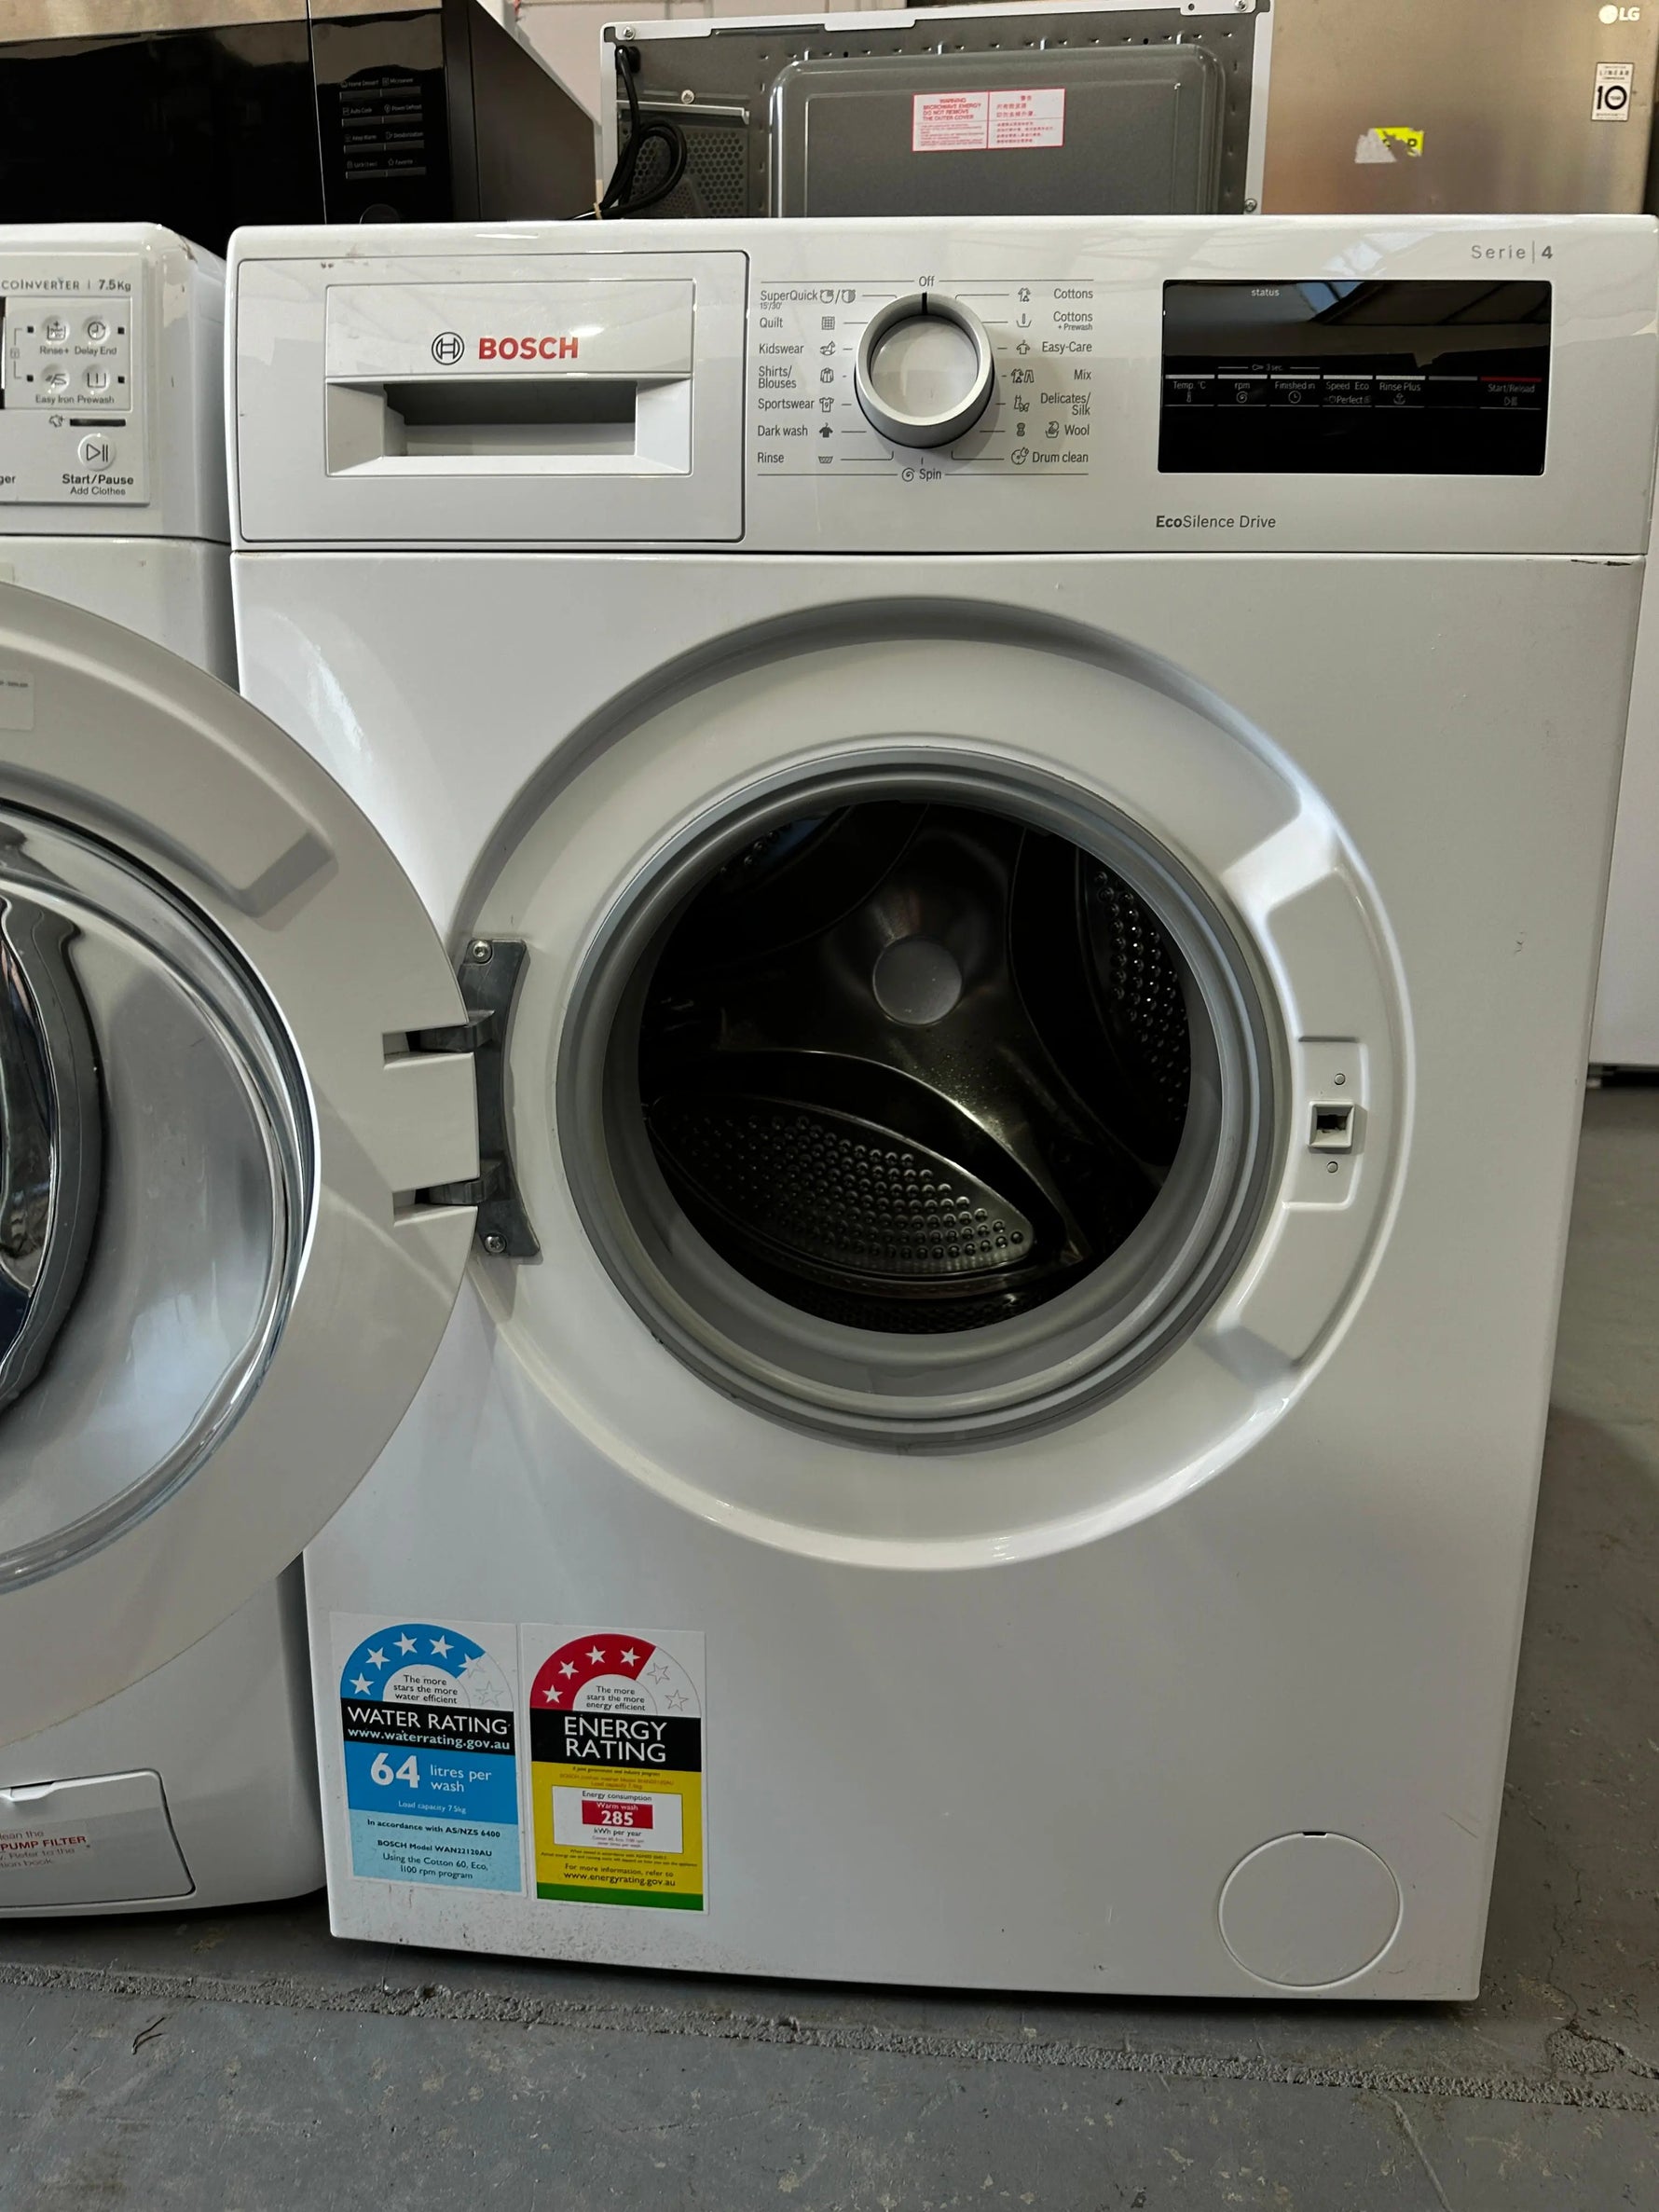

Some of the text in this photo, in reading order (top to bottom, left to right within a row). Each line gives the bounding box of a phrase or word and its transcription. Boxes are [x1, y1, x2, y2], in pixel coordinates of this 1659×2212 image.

[1619, 7, 1640, 21] LG
[1597, 85, 1627, 110] 10
[1471, 244, 1554, 260] Serie 4
[99, 280, 131, 292] 7.5Kg
[918, 276, 935, 288] Off
[760, 290, 818, 303] SuperQuick
[1053, 288, 1093, 300] Cottons
[1251, 287, 1281, 297] status
[760, 316, 784, 329] Quilt
[1052, 311, 1093, 323] Cottons
[1063, 322, 1093, 332] Prewash
[39, 346, 69, 355] Rinse+
[75, 346, 117, 357] Delay End
[479, 337, 579, 360] BOSCH
[758, 342, 804, 355] Kidswear
[1041, 341, 1092, 355] Easy-Care
[758, 364, 793, 379] Shirts/
[1074, 369, 1092, 381] Mix
[758, 377, 797, 390] Blouses
[1234, 382, 1251, 391] rpm
[1274, 381, 1316, 390] Finished in
[1325, 381, 1351, 392] Speed
[1354, 382, 1370, 391] Eco
[1379, 382, 1421, 392] Rinse Plus
[1488, 384, 1536, 394] Start/Reload
[35, 395, 75, 405] Easy Iron
[77, 395, 115, 405] Prewash
[758, 397, 815, 412] Sportswear
[1040, 392, 1091, 406] Delicates/
[1337, 395, 1364, 405] Perfect
[1072, 404, 1091, 417] Silk
[757, 424, 808, 436] Dark wash
[1064, 424, 1090, 436] Wool
[757, 452, 785, 464] Rinse
[1032, 450, 1089, 463] Drum clean
[62, 474, 134, 486] Start/Pause
[919, 468, 942, 482] Spin
[70, 487, 126, 496] Add Clothes
[1156, 515, 1277, 529] EcoSilence Drive
[404, 1674, 447, 1686] The more
[393, 1684, 459, 1697] stars the more
[596, 1685, 611, 1695] The
[394, 1693, 458, 1705] water efficient
[586, 1694, 607, 1703] stars
[608, 1694, 623, 1703] the
[585, 1701, 646, 1711] energy efficient
[348, 1706, 509, 1736] WATER RATING
[564, 1716, 667, 1742] ENERGY
[348, 1728, 511, 1751] www.waterrating.gov.au
[566, 1738, 666, 1764] RATING
[370, 1752, 420, 1789] 64
[430, 1764, 492, 1783] litres per
[431, 1780, 465, 1793] wash
[582, 1790, 652, 1802] Energy consumption
[398, 1800, 416, 1808] Load
[418, 1803, 446, 1813] capacity
[596, 1802, 619, 1810] Warm
[601, 1810, 634, 1826] 285
[377, 1820, 423, 1831] accordance
[425, 1824, 444, 1834] with
[446, 1826, 479, 1836] AS/NZS
[481, 1830, 500, 1838] 6400
[594, 1827, 611, 1835] kWh
[612, 1829, 625, 1837] per
[1, 1835, 87, 1851] PUMP FILTER
[377, 1839, 407, 1849] BOSCH
[409, 1843, 432, 1851] Model
[382, 1853, 489, 1871] Using the Cotton 60, Eco,
[400, 1865, 473, 1880] 1100 rpm program
[563, 1872, 676, 1887] www.energyrating.gov.au
